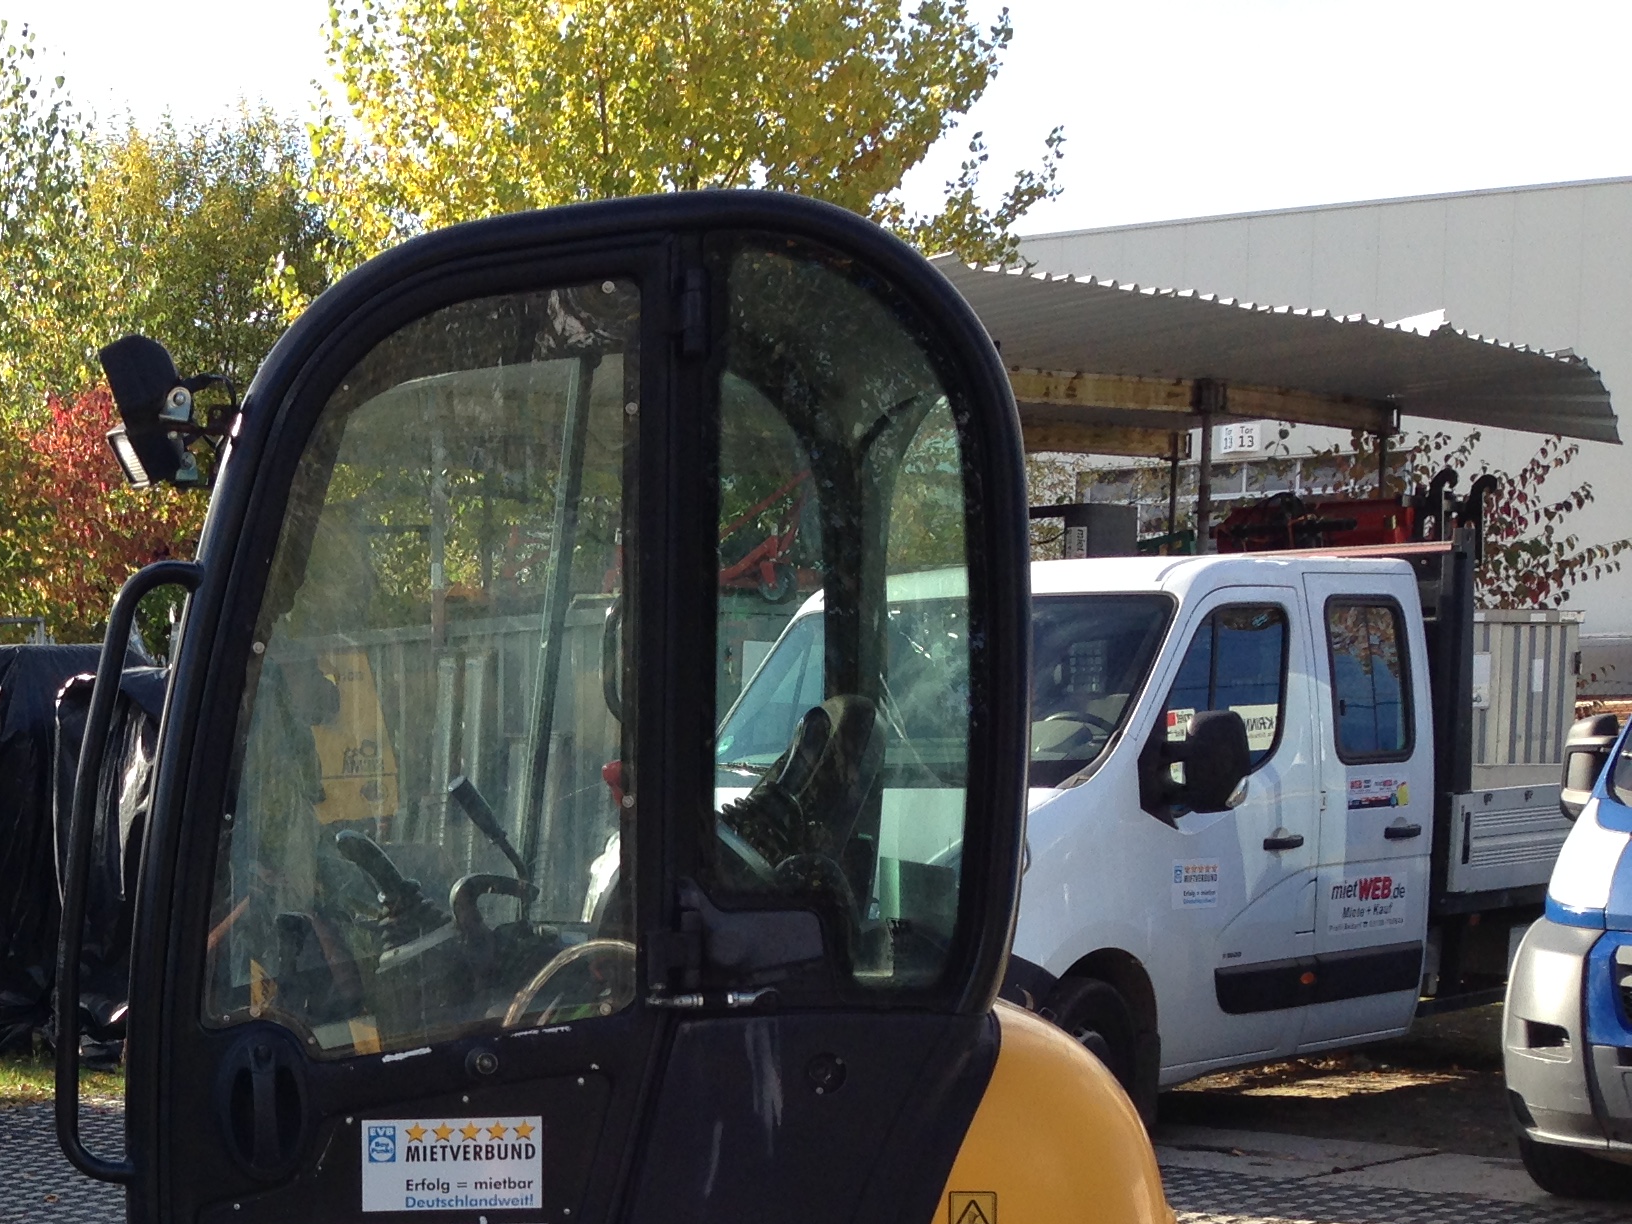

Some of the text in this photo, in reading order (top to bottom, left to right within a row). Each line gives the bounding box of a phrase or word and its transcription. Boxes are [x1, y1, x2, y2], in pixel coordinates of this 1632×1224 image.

[1239, 425, 1254, 434] Tor
[1238, 435, 1254, 448] 13
[1331, 876, 1406, 902] mietWEB.de
[369, 1126, 395, 1137] EVB
[405, 1143, 537, 1163] MIETVERBUND
[405, 1178, 451, 1194] Erfolg
[474, 1176, 534, 1190] mietbar
[405, 1193, 535, 1208] Deutschlandweit!
